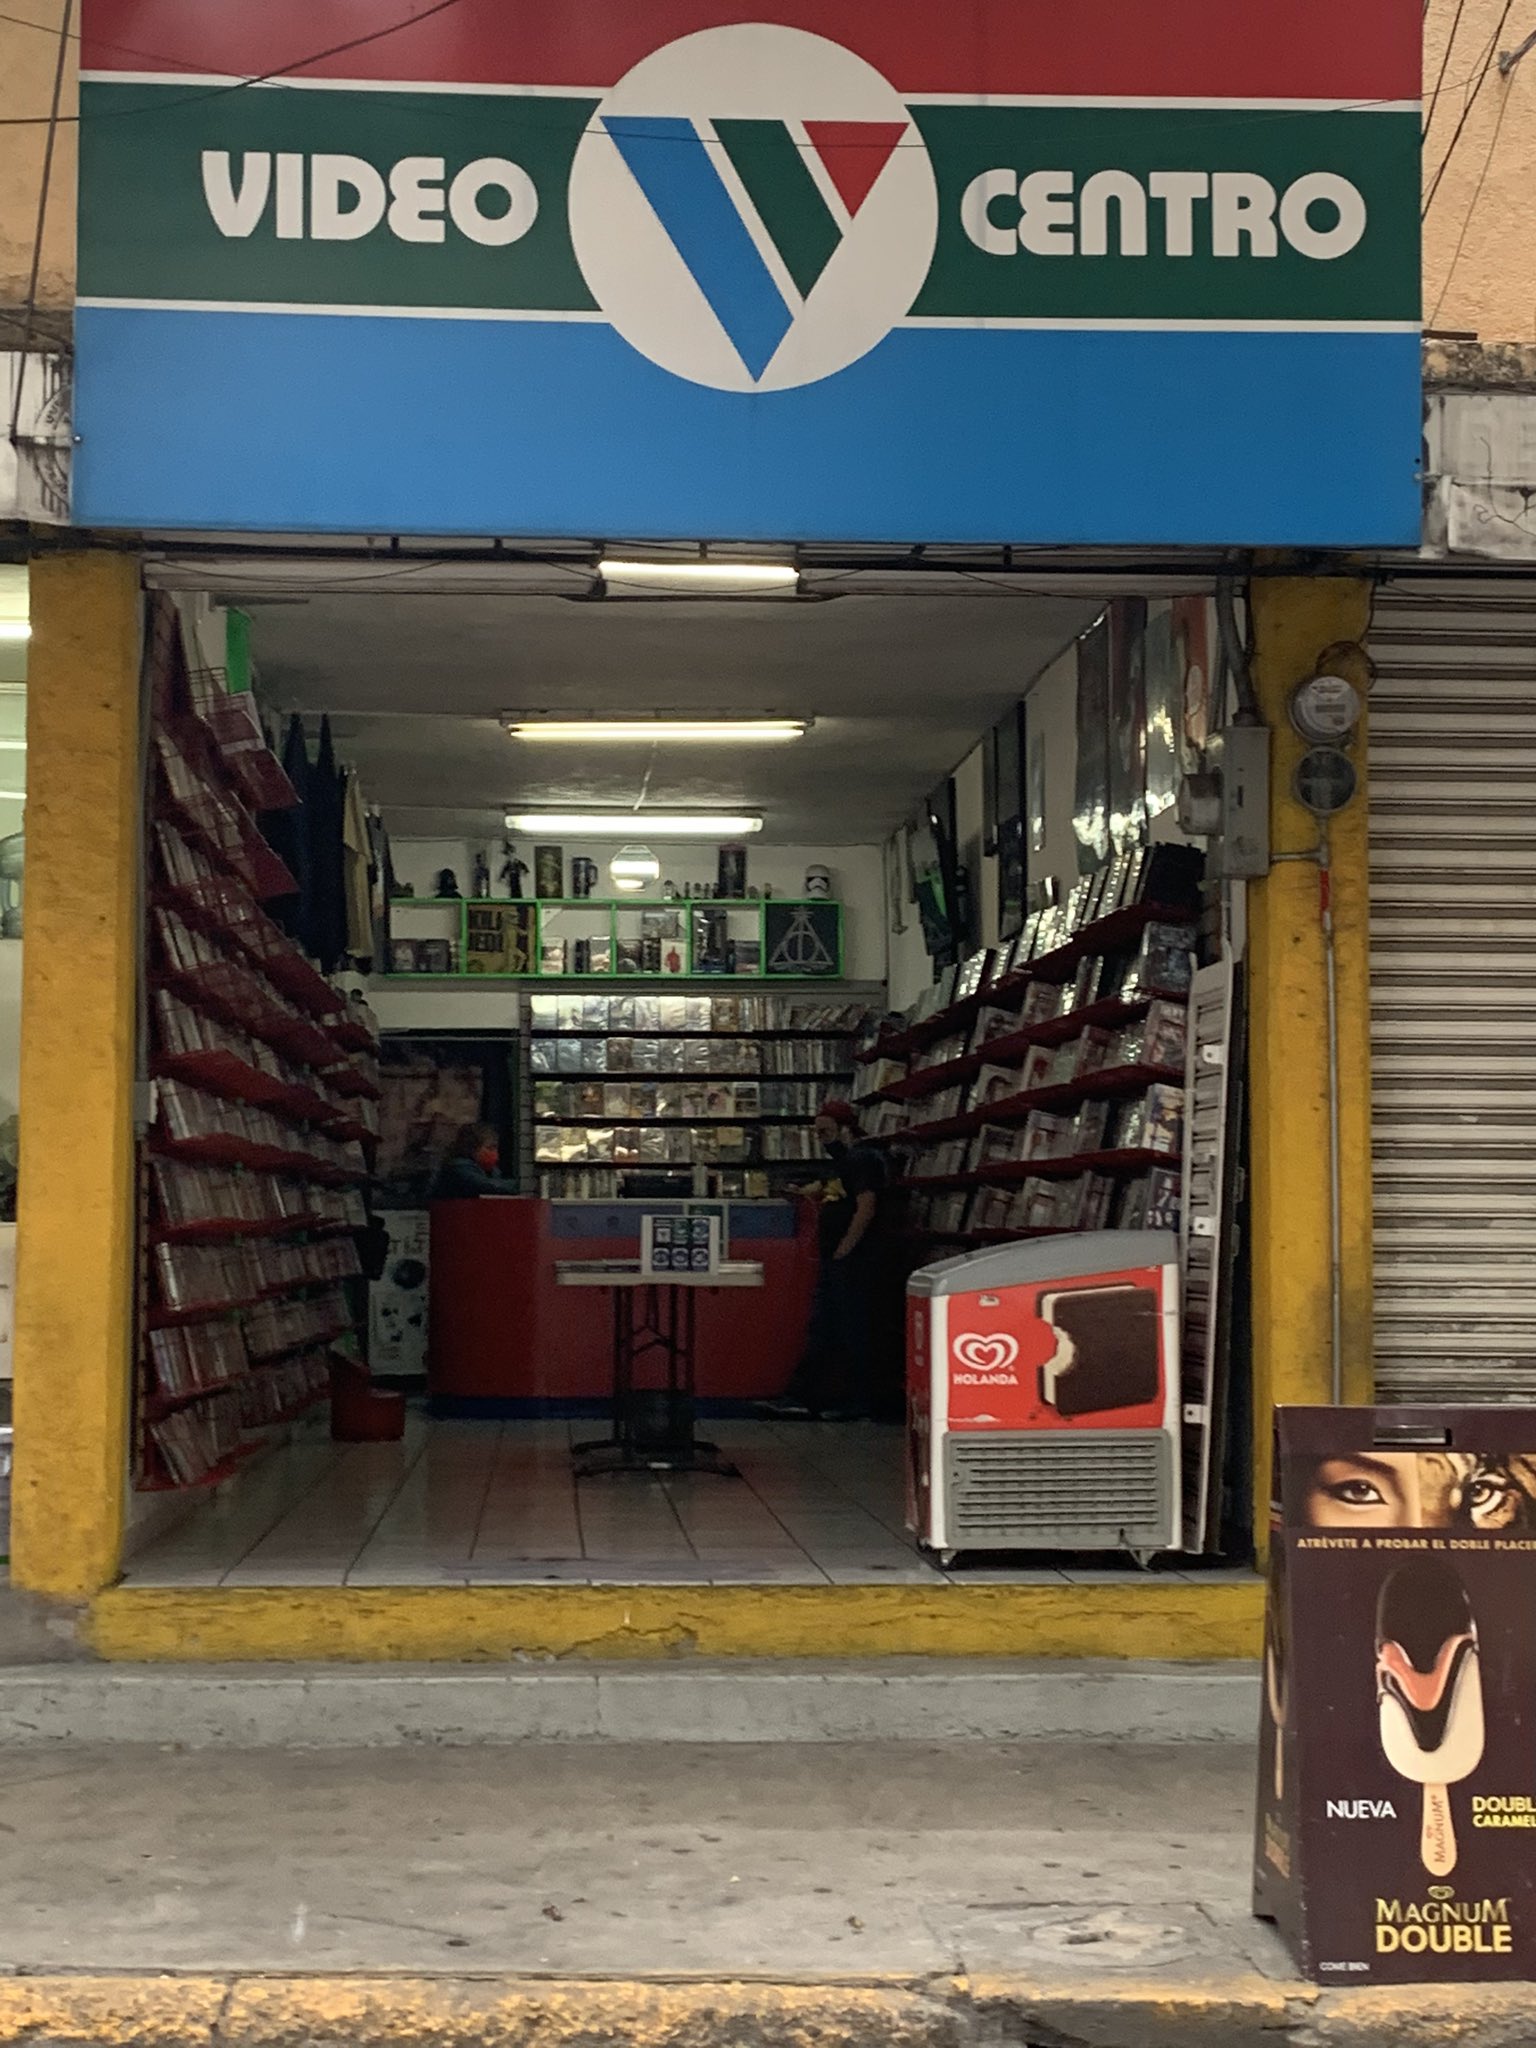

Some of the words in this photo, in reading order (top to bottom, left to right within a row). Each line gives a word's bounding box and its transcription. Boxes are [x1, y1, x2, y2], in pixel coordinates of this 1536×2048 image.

[201, 150, 540, 247] VIDEO
[960, 168, 1368, 260] CENTRO
[953, 1373, 1019, 1385] HOLANDA
[1362, 1538, 1373, 1548] A
[1376, 1538, 1429, 1549] PROBAR
[1432, 1539, 1446, 1549] EL
[1450, 1539, 1490, 1550] DOBLE
[1326, 1800, 1397, 1819] NUEVA
[1375, 1898, 1512, 1923] MAGNUM
[1376, 1925, 1513, 1953] DOUBLE
